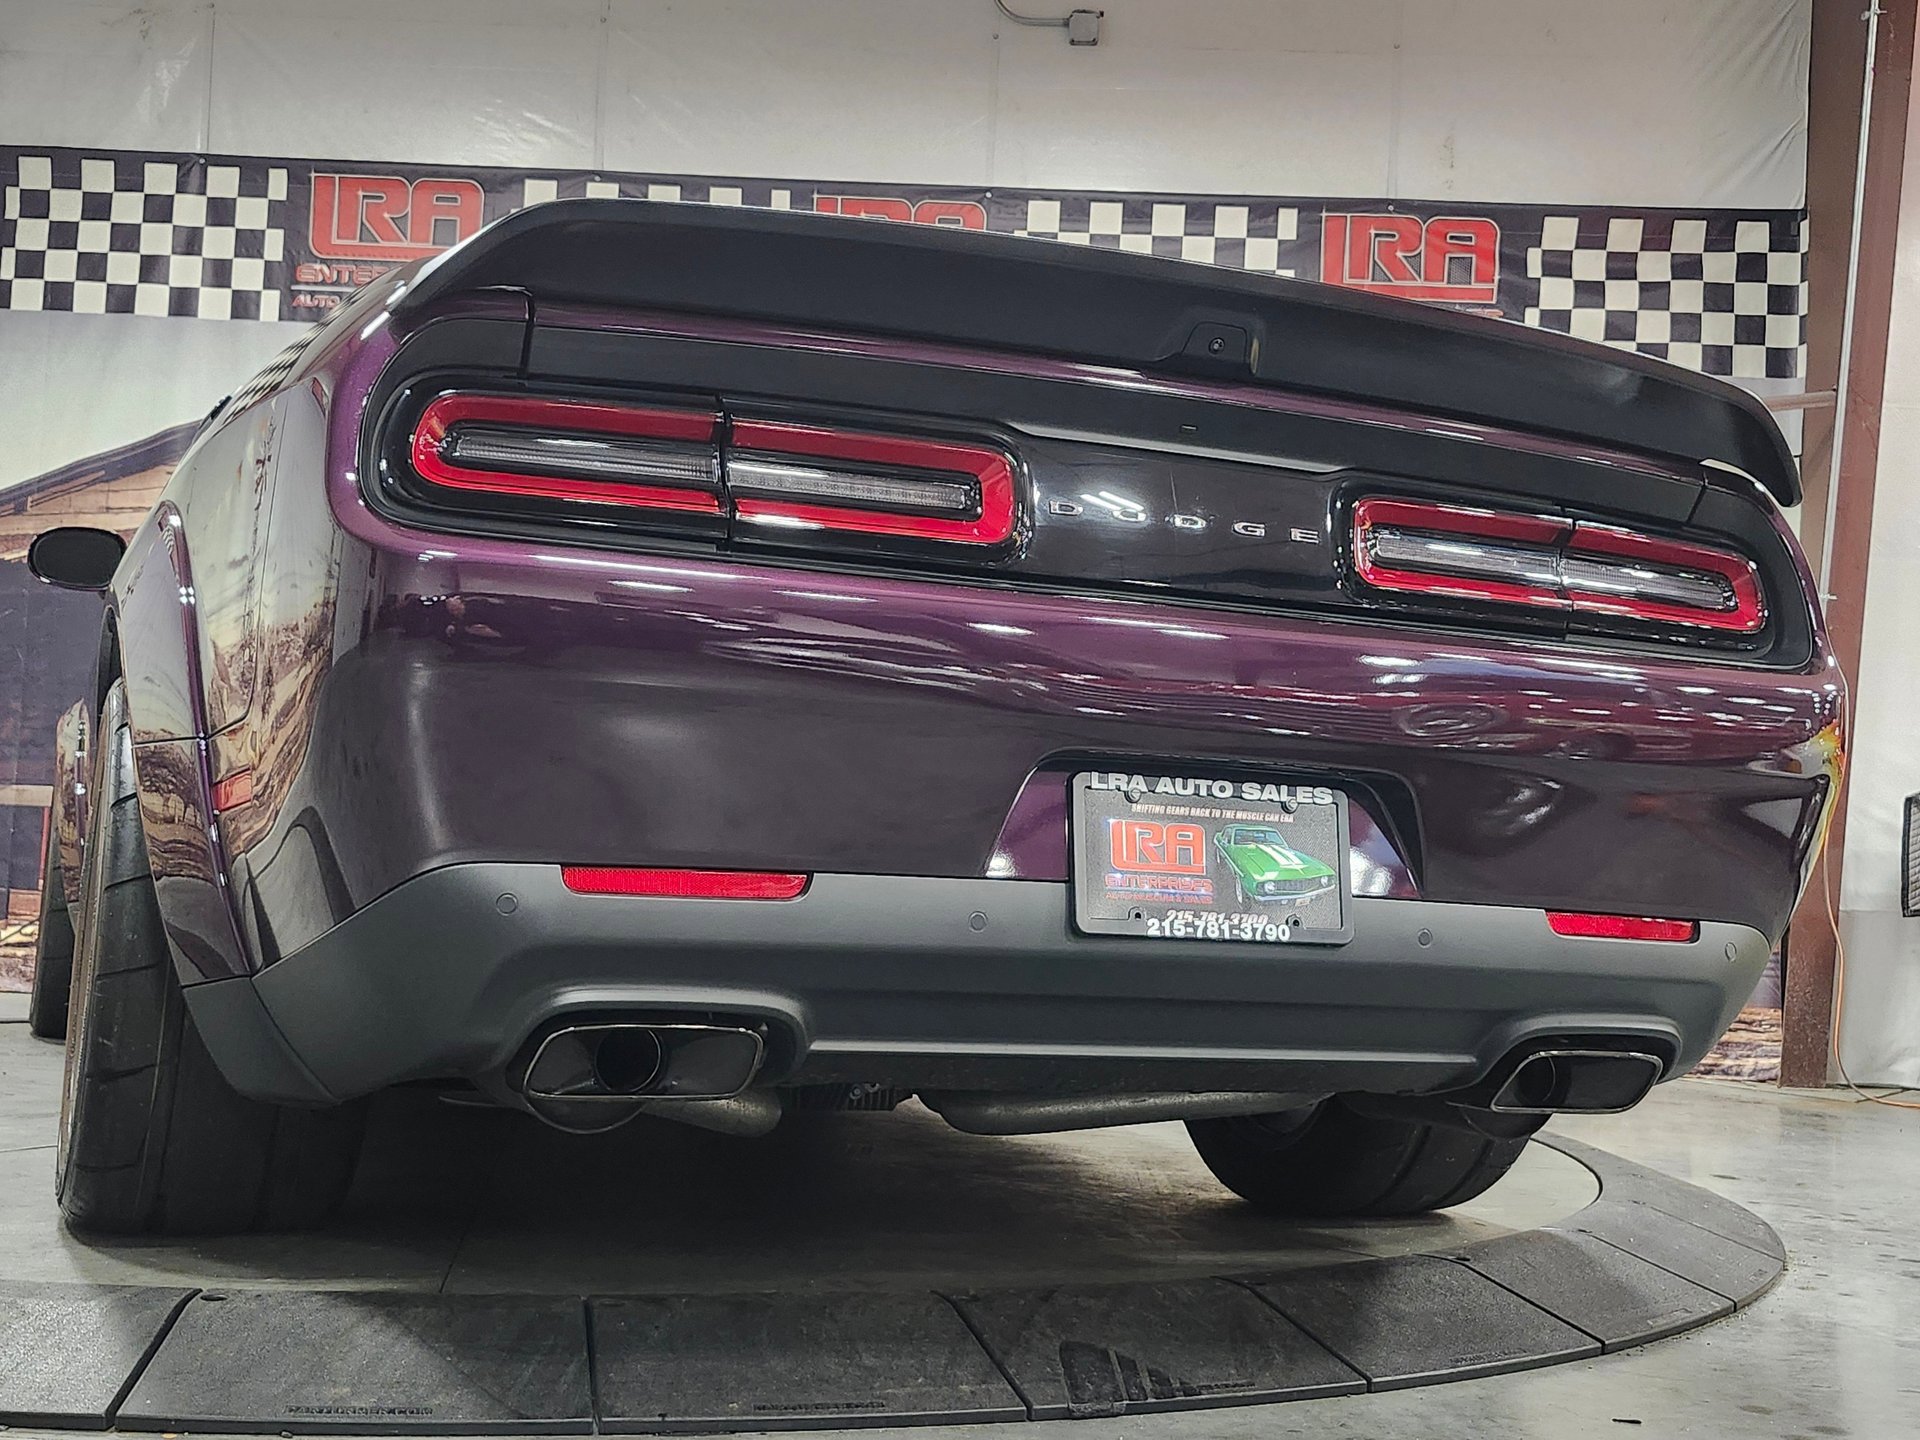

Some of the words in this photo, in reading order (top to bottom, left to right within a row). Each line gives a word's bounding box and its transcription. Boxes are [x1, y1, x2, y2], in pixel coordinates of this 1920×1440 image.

[1049, 500, 1320, 544] DODGE
[1090, 771, 1148, 793] LRA
[1155, 776, 1234, 799] AUTO
[1241, 782, 1333, 805] SALES
[1131, 803, 1166, 815] SHIFTING
[1166, 805, 1190, 816] GEARS
[1190, 807, 1211, 818] BACK
[1211, 808, 1221, 818] TO
[1221, 809, 1236, 819] THE
[1235, 810, 1264, 821] MUSCLE
[1264, 812, 1280, 823] CAR
[1280, 814, 1294, 823] ERA
[1110, 820, 1206, 875] LRA
[1147, 918, 1291, 942] 215-781-3790
